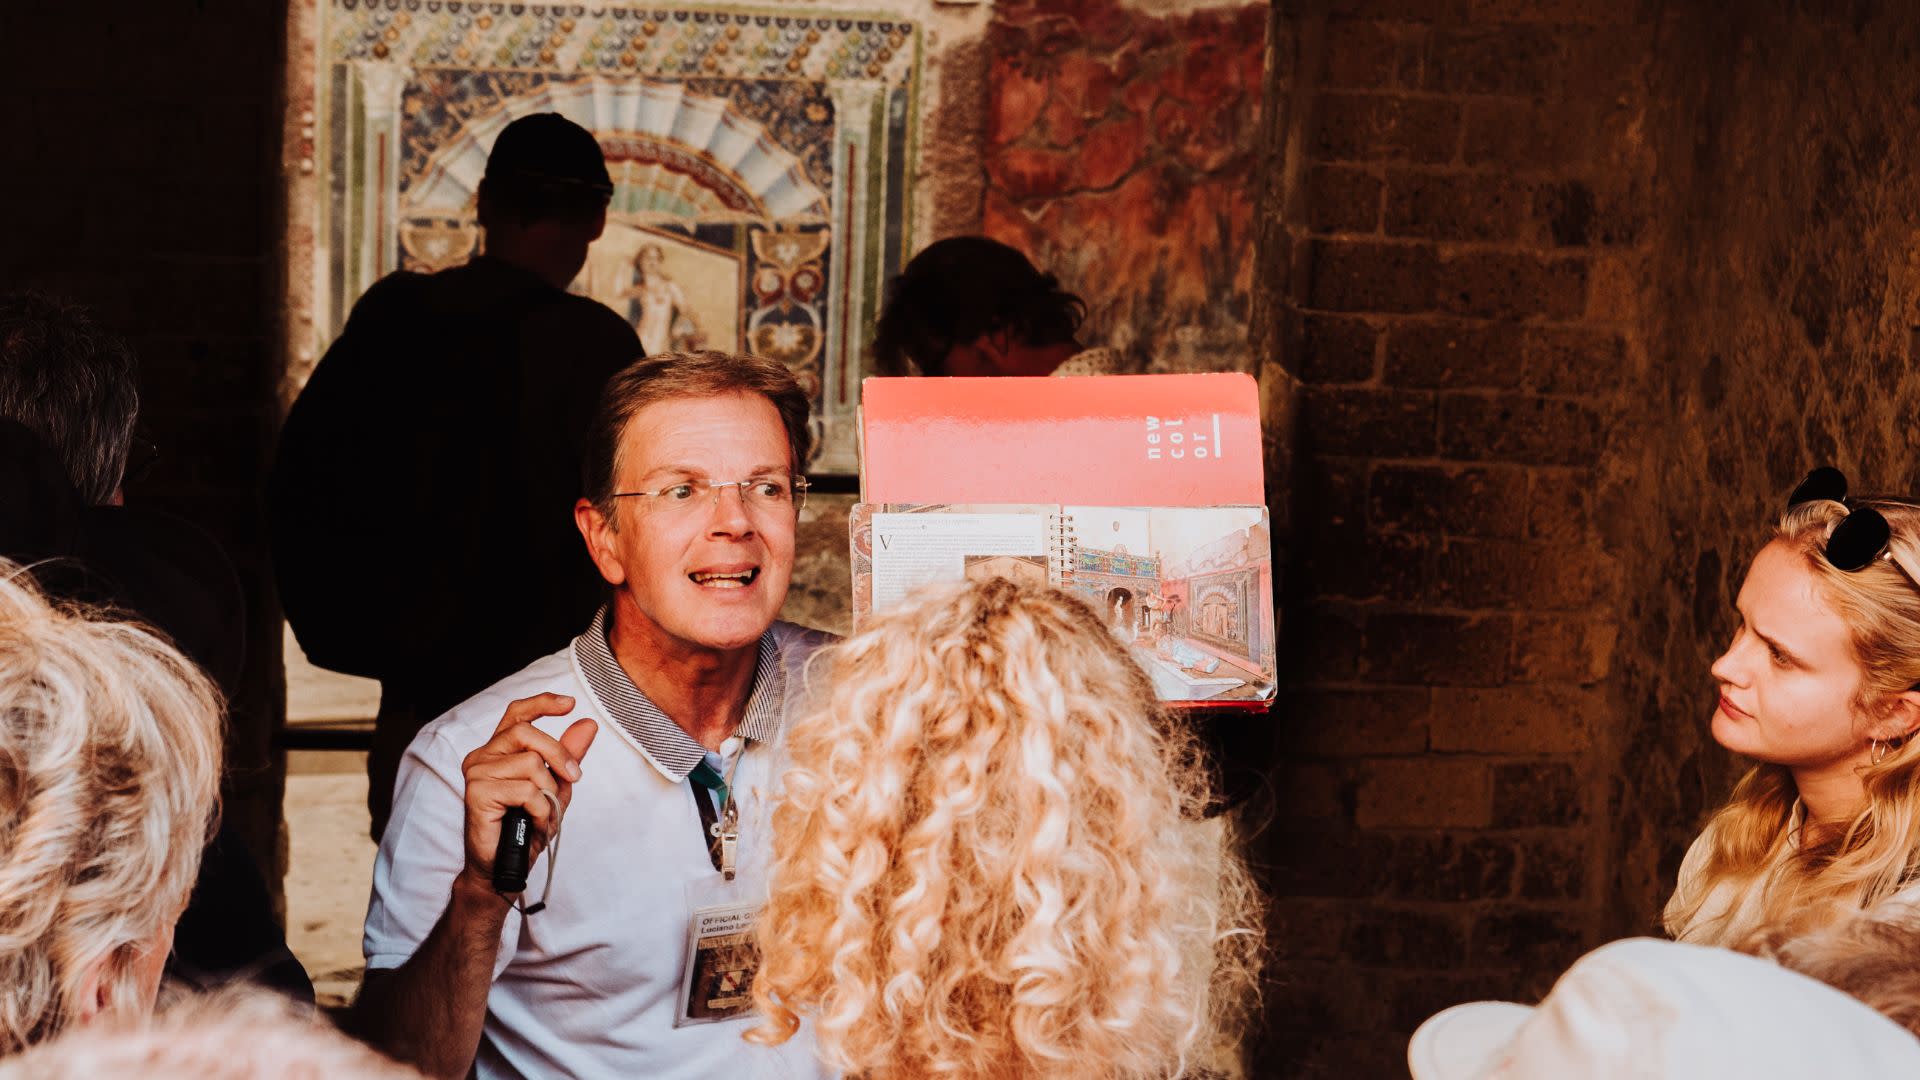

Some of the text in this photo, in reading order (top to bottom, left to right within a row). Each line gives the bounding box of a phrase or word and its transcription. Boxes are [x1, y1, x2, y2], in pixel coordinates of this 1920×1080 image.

[1146, 415, 1161, 459] new
[1165, 419, 1185, 459] col
[1193, 432, 1208, 458] or
[701, 925, 734, 934] Luciano
[702, 914, 740, 925] OFFICIAL
